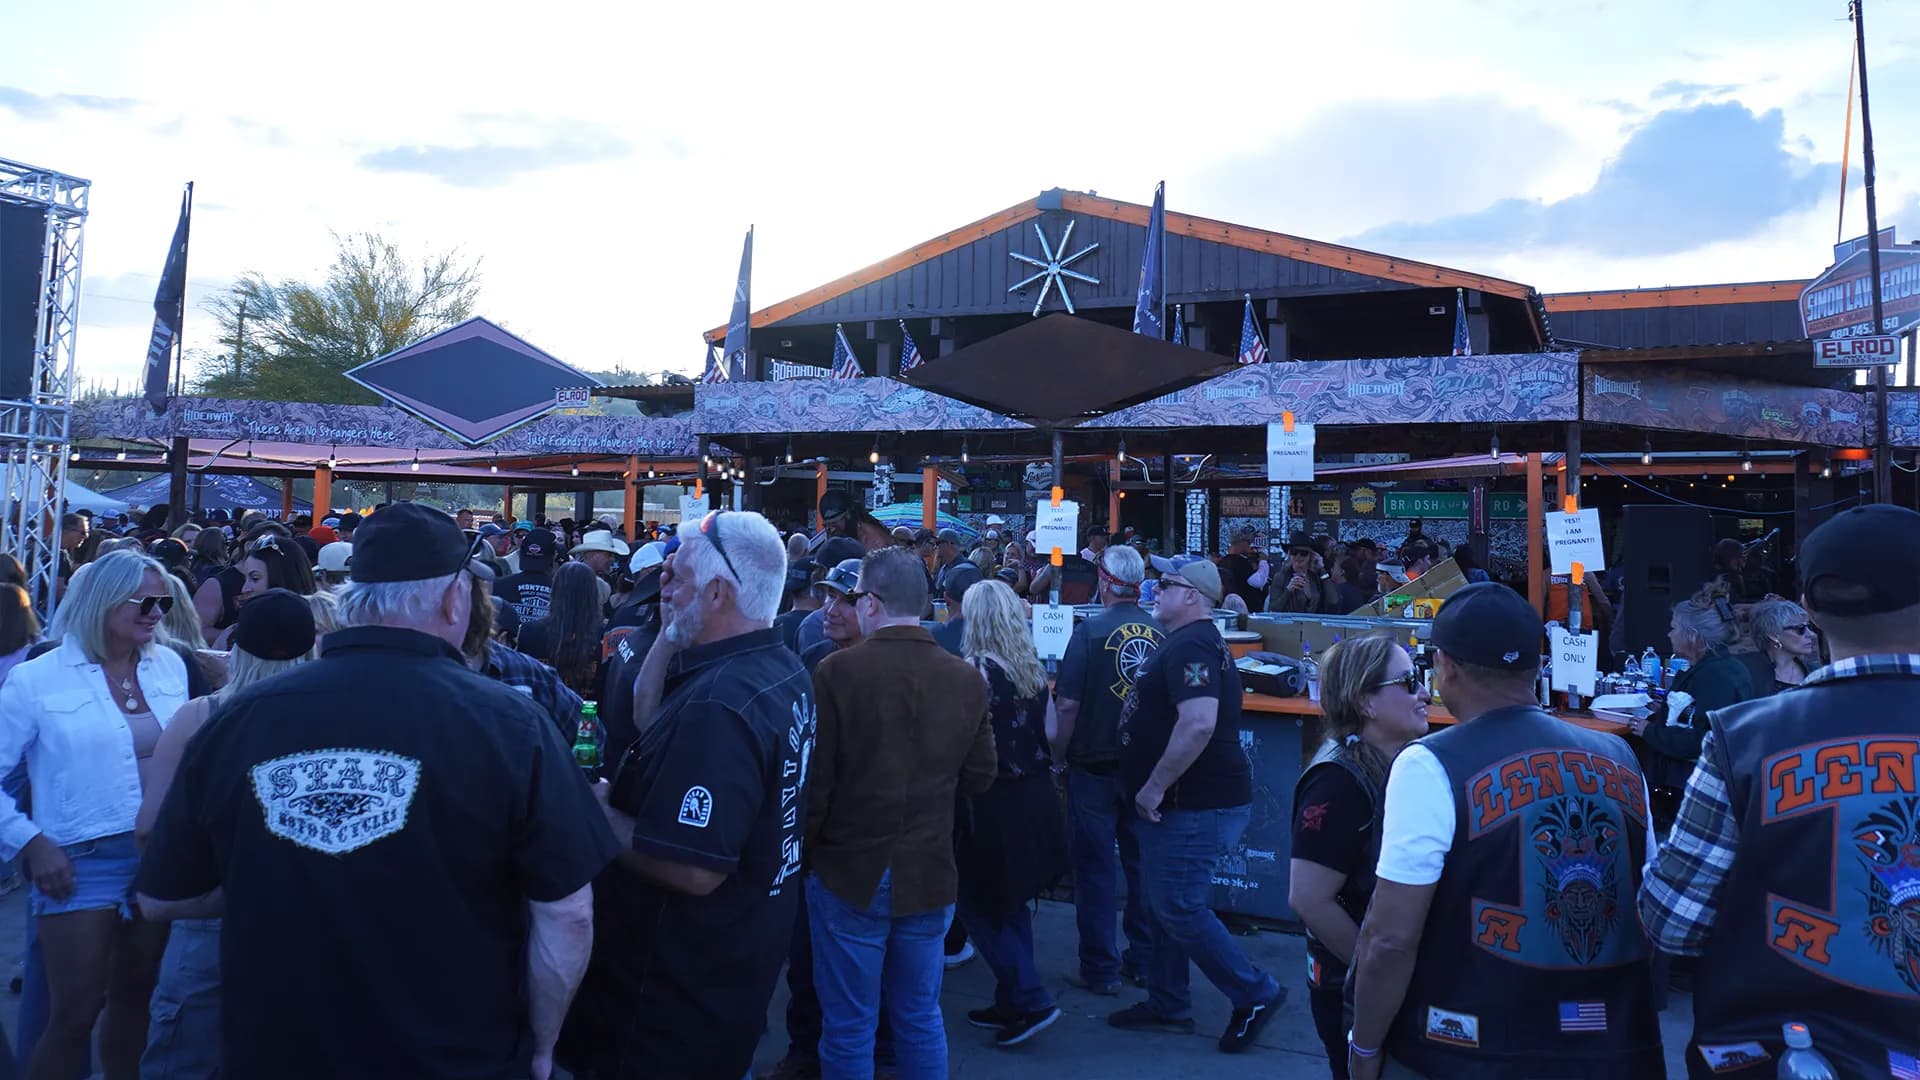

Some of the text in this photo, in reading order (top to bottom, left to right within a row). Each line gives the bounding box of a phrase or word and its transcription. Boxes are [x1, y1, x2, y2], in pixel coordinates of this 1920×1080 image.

[1807, 284, 1843, 322] SIMON
[1880, 263, 1920, 303] GROU
[1822, 339, 1895, 358] ELROD
[558, 390, 587, 402] ELROD
[1348, 381, 1405, 397] HIDEAWAY
[184, 408, 235, 423] HIDEAWAY
[284, 423, 300, 435] Are
[305, 426, 316, 437] No
[319, 426, 367, 441] Strangers
[527, 431, 546, 446] Just
[1555, 537, 1595, 546] PREGNANT!!
[1042, 612, 1064, 620] CASH
[1042, 625, 1064, 634] ONLY
[1121, 624, 1154, 640] KOA
[1562, 636, 1587, 648] CASH
[1563, 652, 1586, 664] ONLY
[268, 758, 407, 801] STAR
[1770, 741, 1918, 815] LEN
